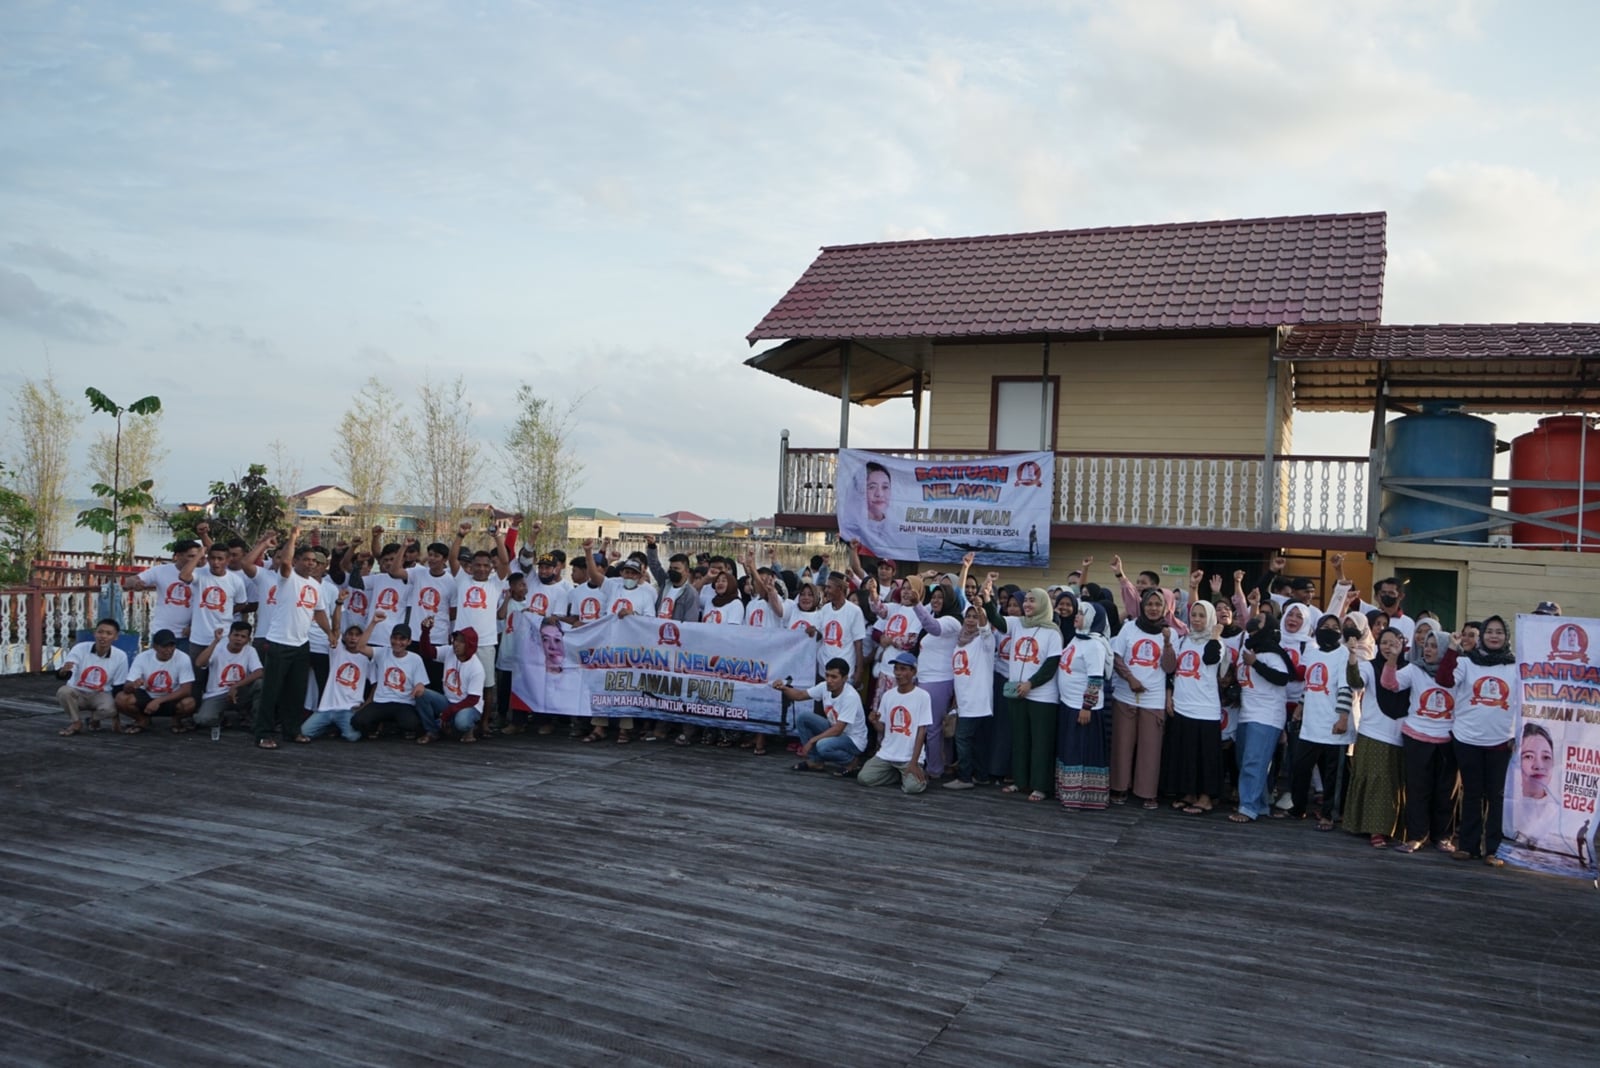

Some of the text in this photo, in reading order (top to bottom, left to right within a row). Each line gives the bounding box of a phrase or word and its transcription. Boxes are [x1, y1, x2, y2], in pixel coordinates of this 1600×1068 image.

[914, 466, 1009, 483] BANTUAN
[922, 483, 1001, 502] NELAYAN
[905, 507, 1012, 526] RELAWAN PUAN
[972, 528, 1001, 536] PRESIDEN
[1002, 528, 1020, 537] 2024
[578, 646, 769, 684] BANTUAN NELAYAN
[1520, 662, 1600, 685] BANTUA
[605, 671, 735, 703] RELAWAN PUAN
[592, 695, 611, 705] PUAN
[658, 699, 684, 711] UNTUK
[686, 702, 725, 717] PRESIDEN
[726, 707, 748, 719] 2024
[1565, 771, 1599, 789] UNTUK
[1564, 783, 1598, 798] PRESIDEN
[1563, 794, 1595, 813] 2024
